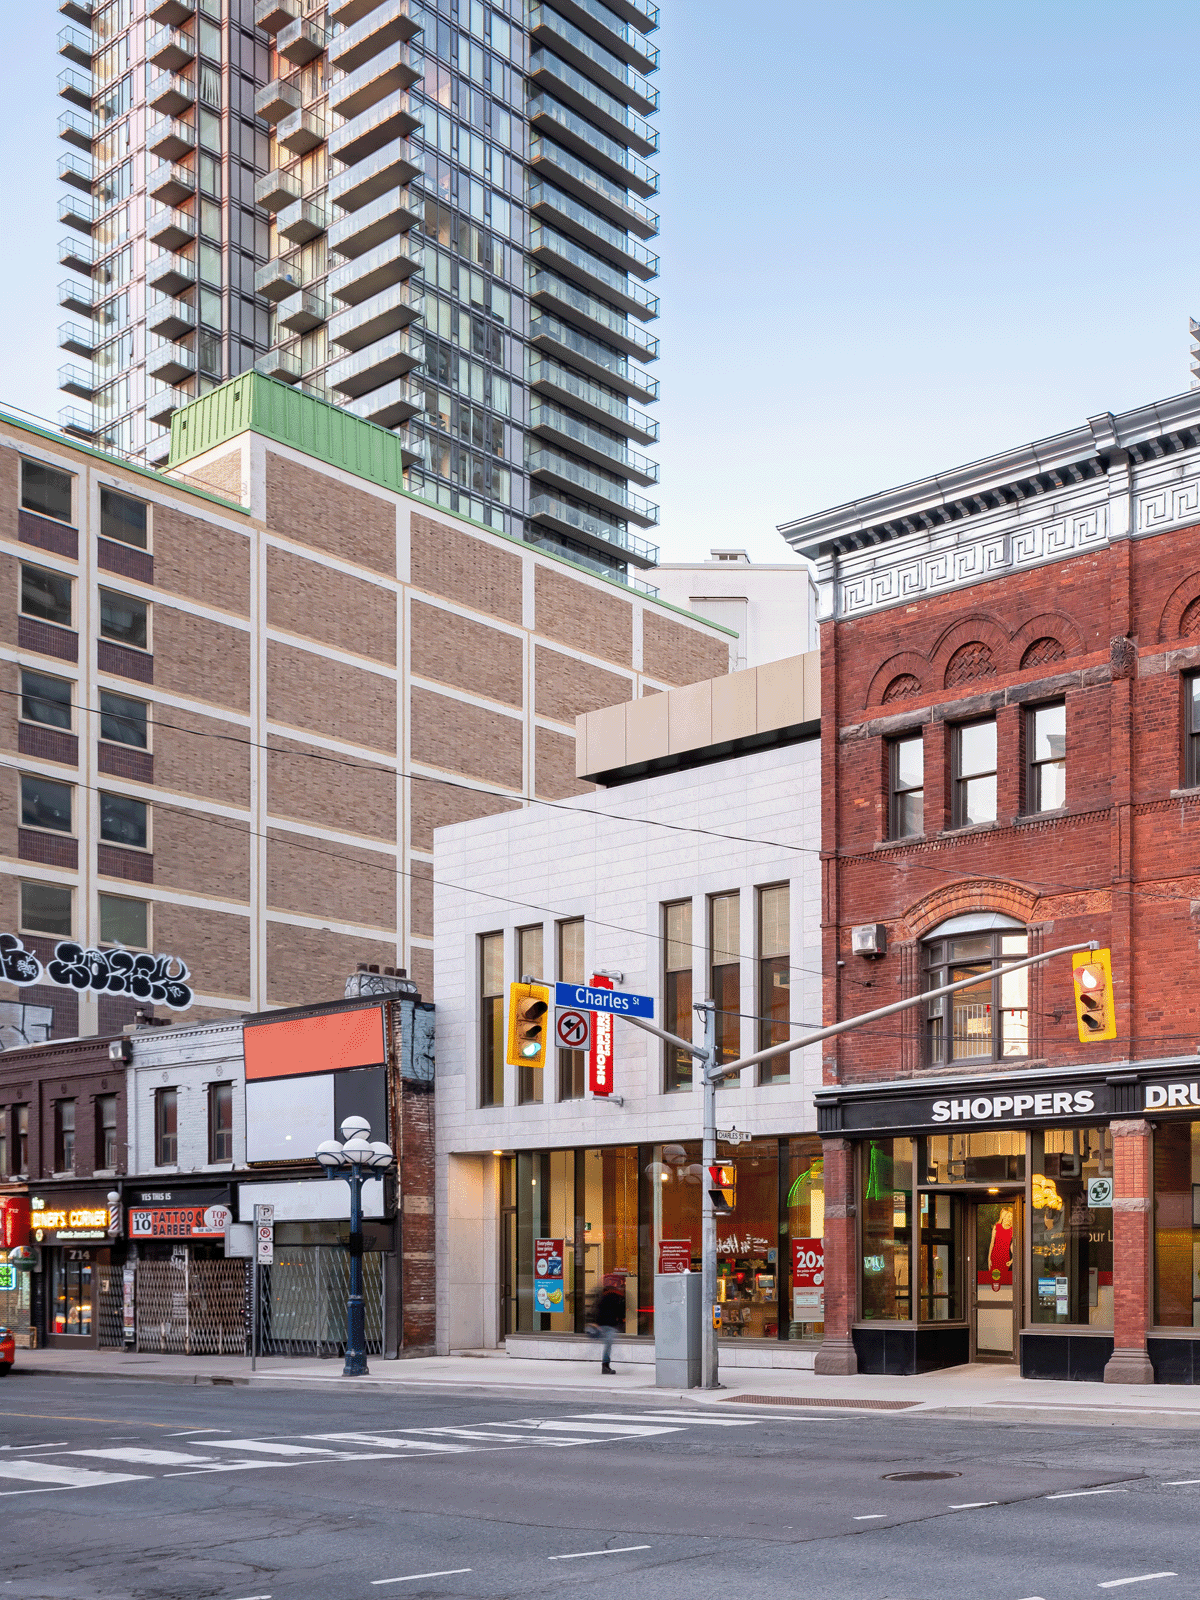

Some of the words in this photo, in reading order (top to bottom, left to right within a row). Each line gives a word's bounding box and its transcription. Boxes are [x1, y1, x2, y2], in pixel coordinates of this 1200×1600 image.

[575, 987, 629, 1010] Charles
[632, 996, 640, 1006] St
[931, 1091, 1094, 1122] SHOPPERS
[719, 1132, 738, 1140] CHARLES
[141, 1193, 151, 1201] YES
[152, 1192, 164, 1200] THIS
[165, 1192, 171, 1200] IS
[32, 1196, 45, 1210] the
[152, 1211, 194, 1223] TATTOO
[211, 1210, 227, 1219] TOP
[134, 1220, 151, 1230] 10
[213, 1219, 224, 1227] 10
[152, 1224, 192, 1236] BARBER
[69, 1250, 90, 1260] 714
[796, 1250, 825, 1269] 20x
